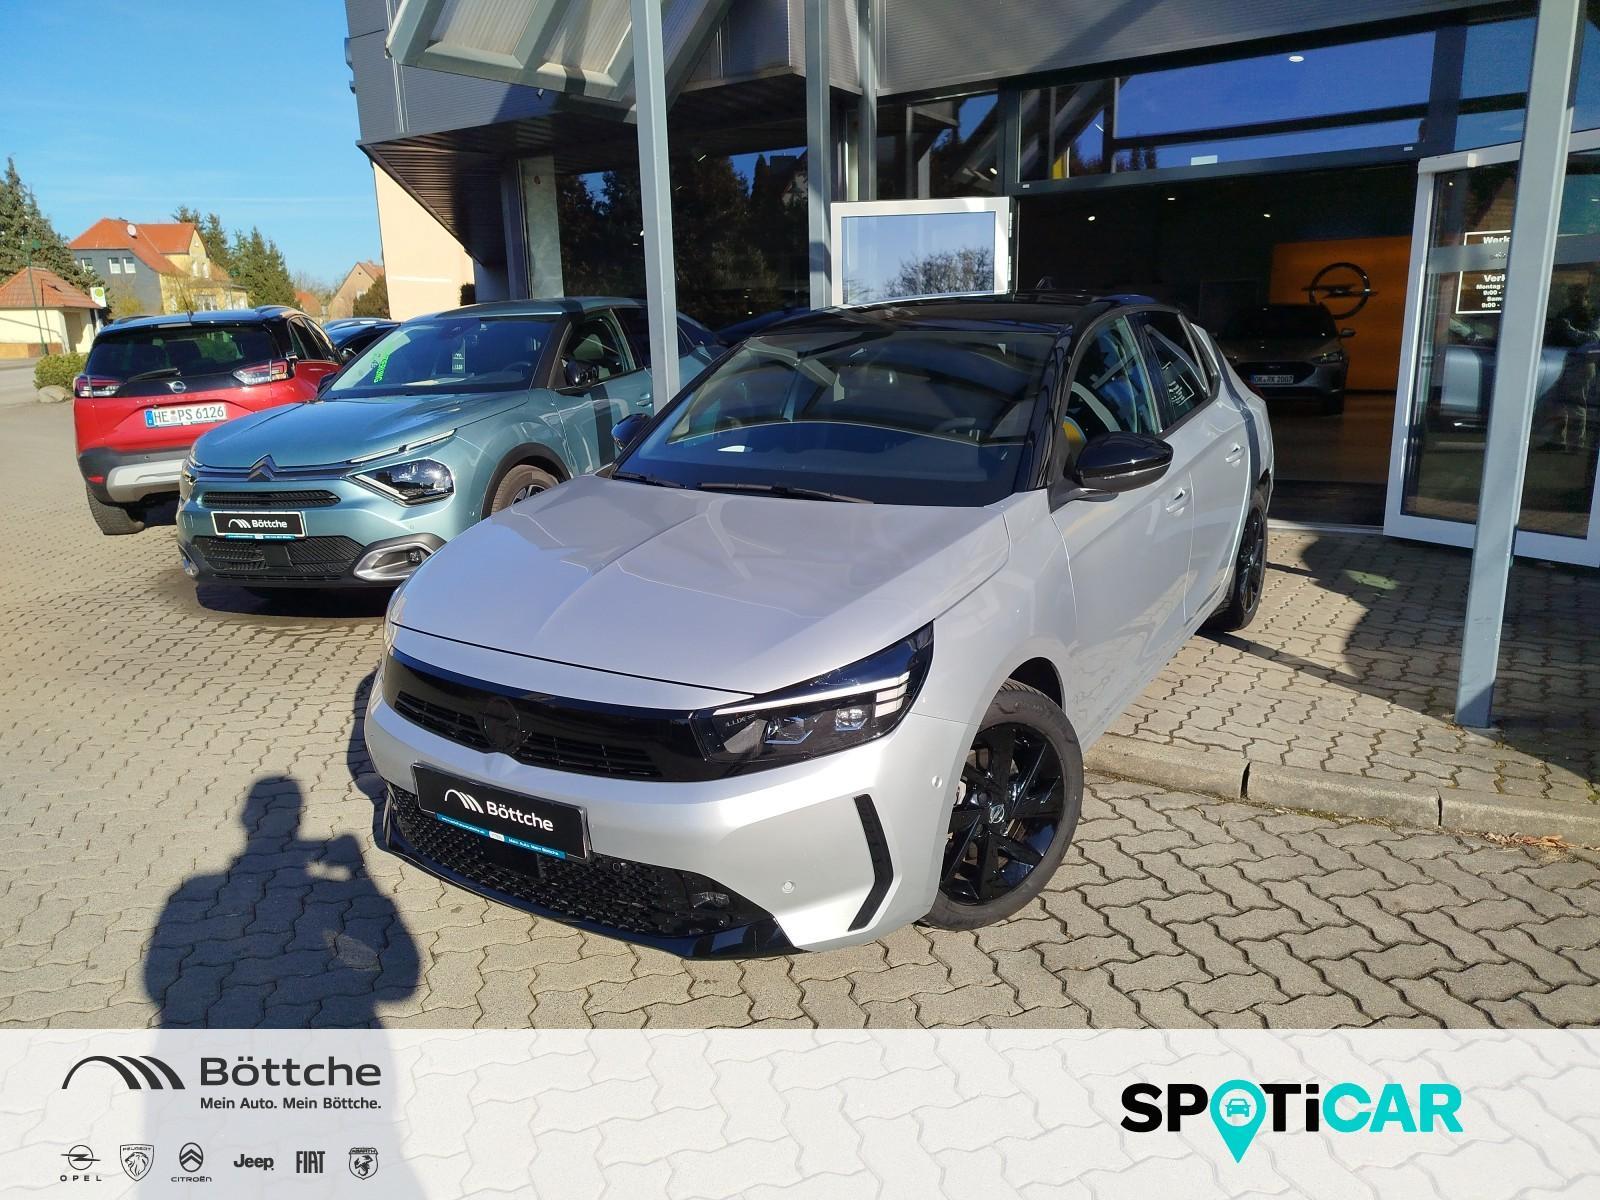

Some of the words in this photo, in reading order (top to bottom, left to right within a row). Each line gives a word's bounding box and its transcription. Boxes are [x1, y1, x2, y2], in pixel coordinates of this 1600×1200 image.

[153, 410, 169, 423] HE
[177, 408, 193, 421] PS
[195, 405, 224, 419] 6126
[251, 519, 288, 529] Böttche
[486, 800, 554, 832] Böttche
